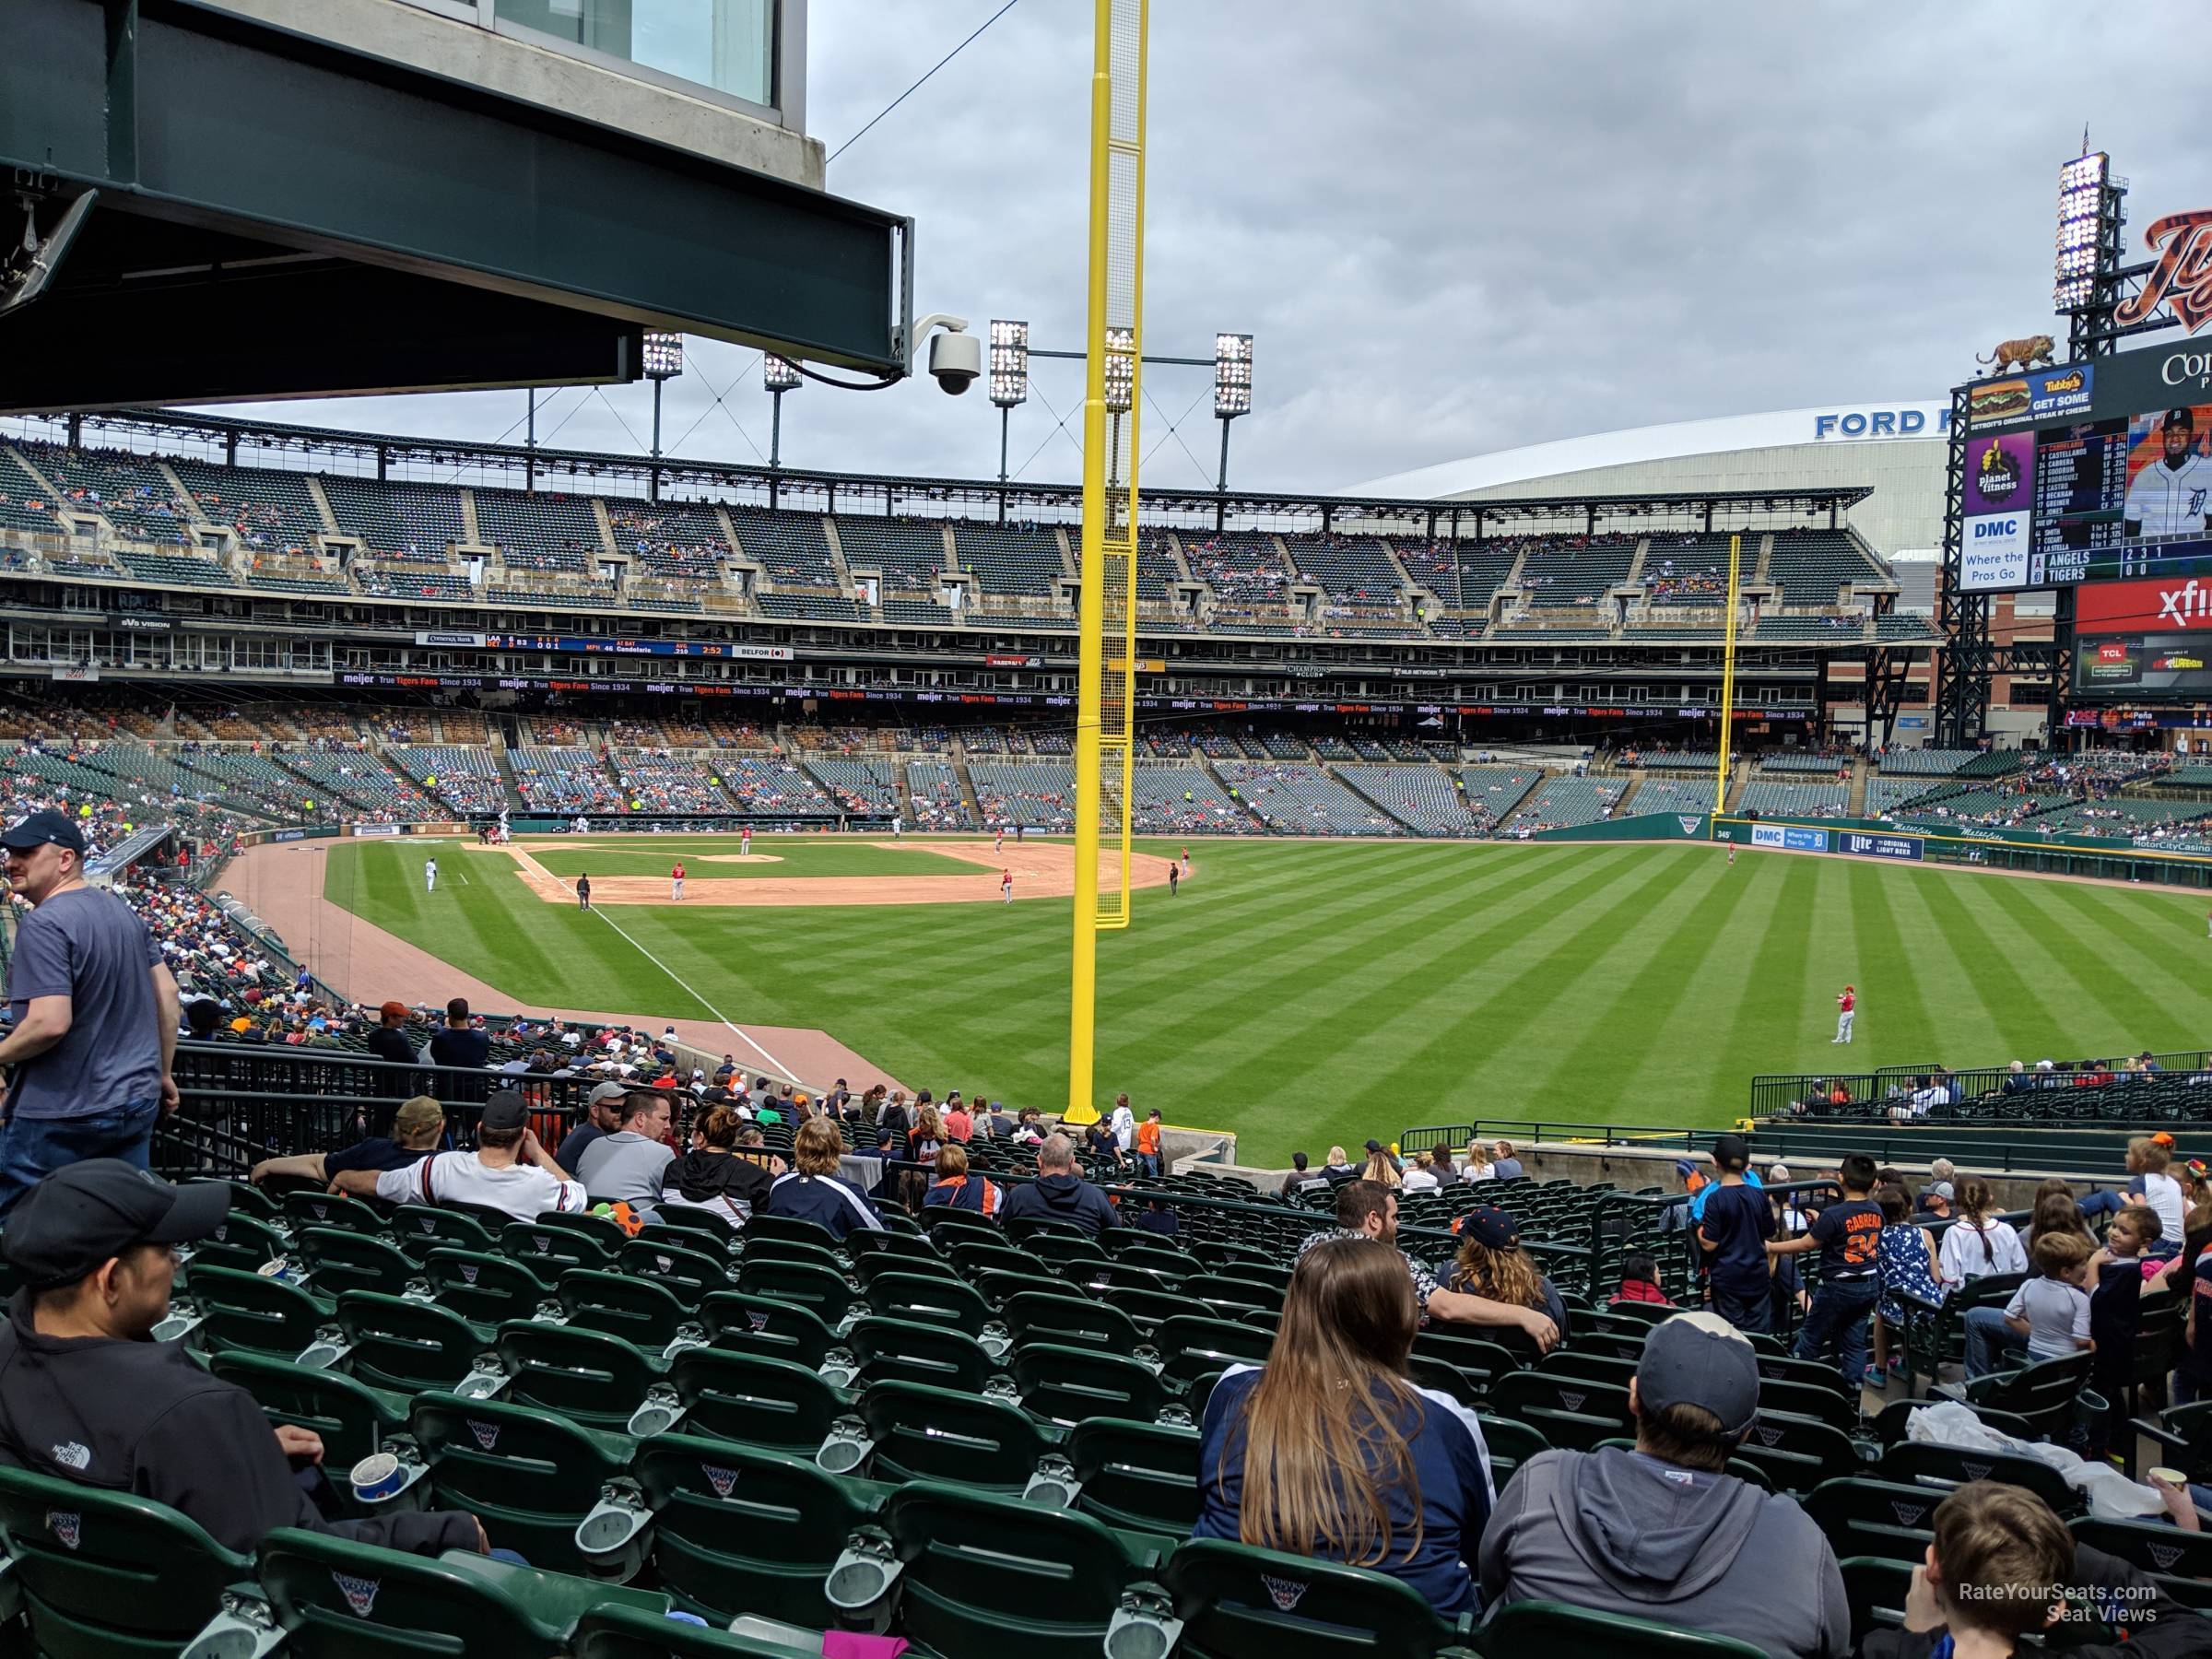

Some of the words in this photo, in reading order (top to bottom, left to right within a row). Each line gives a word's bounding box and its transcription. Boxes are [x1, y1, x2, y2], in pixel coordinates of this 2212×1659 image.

[2045, 377, 2081, 393] Tubby's
[2033, 398, 2056, 411] GET
[2057, 392, 2089, 406] SOME
[1815, 409, 1925, 439] FORD
[1971, 419, 2002, 431] DETROIT'S
[2003, 414, 2034, 425] ORIGINAL
[2035, 411, 2057, 421] STEAK
[2065, 405, 2092, 415] CHEESE
[2048, 447, 2087, 459] CASTELLANOS
[2048, 458, 2074, 468] CABRERA
[2047, 466, 2075, 476] GOODRUM
[1979, 471, 2011, 487] planet
[1983, 481, 2017, 493] fitness
[2047, 482, 2069, 492] CASTRO
[2047, 490, 2073, 499] BECKHAM
[2046, 498, 2070, 507] GREINER
[1975, 519, 2017, 538] DMC
[2044, 535, 2063, 544] COZART
[1966, 554, 2001, 565] Where
[2005, 552, 2024, 562] the
[2049, 552, 2090, 567] ANGELS
[2127, 548, 2133, 560] 2
[2141, 547, 2147, 559] 3
[2157, 546, 2161, 558] 1
[1972, 571, 1995, 582] Pros
[2000, 568, 2015, 579] Go
[2049, 567, 2085, 582] TIGERS
[2126, 564, 2132, 576] 0
[2140, 563, 2146, 575] 0
[2102, 649, 2122, 658] TCL
[344, 673, 374, 684] meijer
[397, 677, 419, 686] Tigers
[500, 679, 528, 688] meijer
[550, 682, 571, 690] Tigers
[647, 684, 674, 693] meijer
[694, 686, 714, 694] Tigers
[786, 688, 811, 698] meijer
[830, 691, 848, 699] Tigers
[917, 692, 942, 702] meijer
[961, 695, 979, 703] Tigers
[1046, 697, 1071, 706] meijer
[1172, 700, 1196, 709] meijer
[1295, 703, 1319, 712] meijer
[1337, 705, 1354, 713] Tigers
[1418, 705, 1441, 714] meijer
[1544, 706, 1569, 716] meijer
[1588, 707, 1607, 717] Tigers
[1679, 709, 1705, 718] meijer
[1755, 830, 1781, 842] DMC
[1850, 835, 1872, 852] Lite
[2133, 840, 2211, 852] MotorCityCasino
[1124, 1118, 1131, 1130] 13
[1845, 1213, 1881, 1233] CABRERA
[1844, 1232, 1879, 1262] 24
[52, 1445, 75, 1457] NORTH
[68, 1441, 81, 1452] THE
[56, 1452, 74, 1465] FACE
